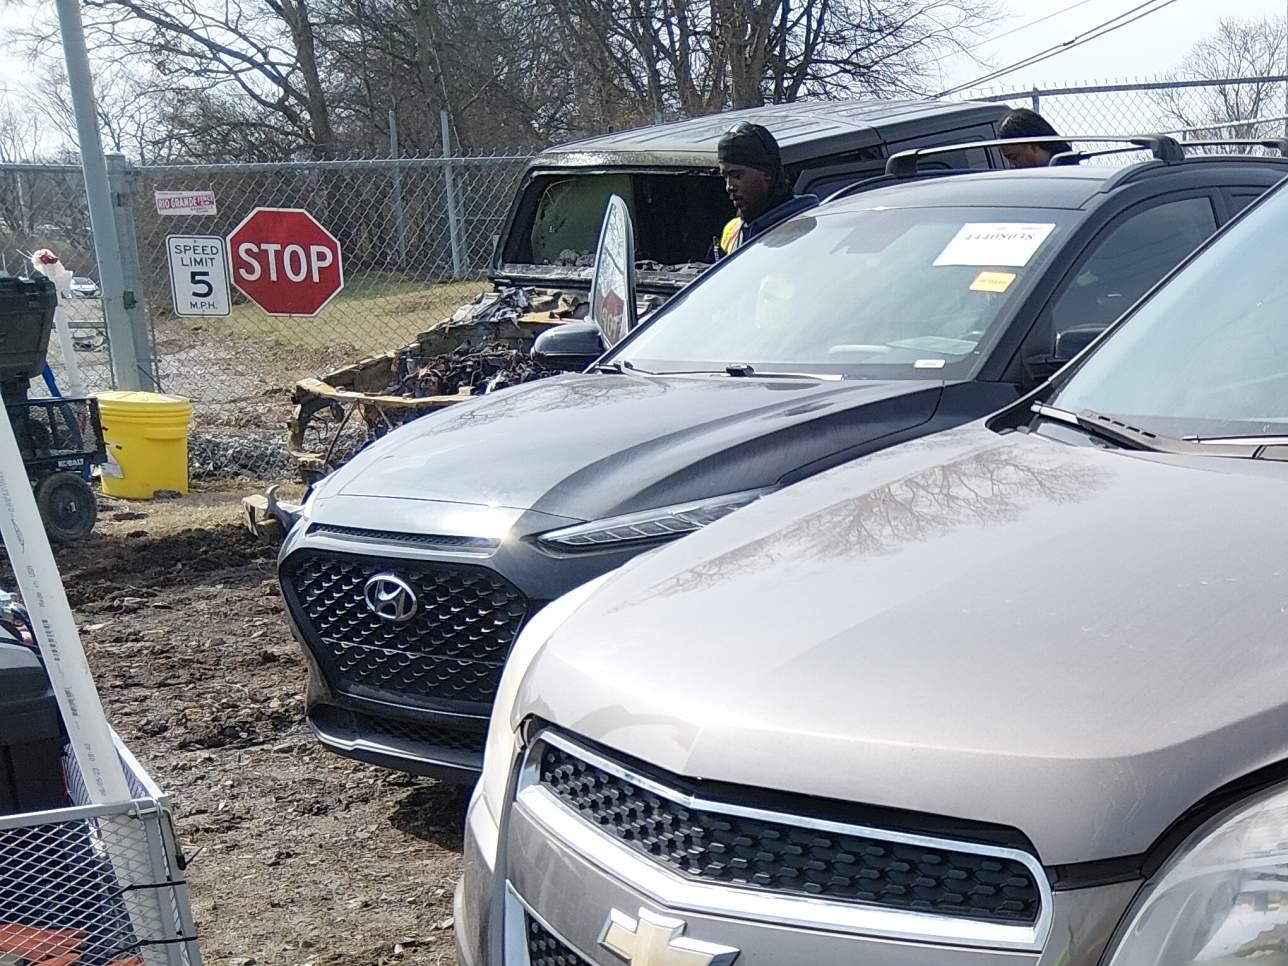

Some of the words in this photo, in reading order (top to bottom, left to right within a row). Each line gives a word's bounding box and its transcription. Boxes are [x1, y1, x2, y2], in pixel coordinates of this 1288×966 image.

[158, 199, 170, 209] RIO
[170, 196, 198, 209] GRANDE
[174, 244, 219, 256] SPEED
[180, 256, 216, 267] LIMIT
[238, 242, 333, 283] STOP
[190, 271, 214, 298] 5
[189, 301, 218, 310] M.P.H.
